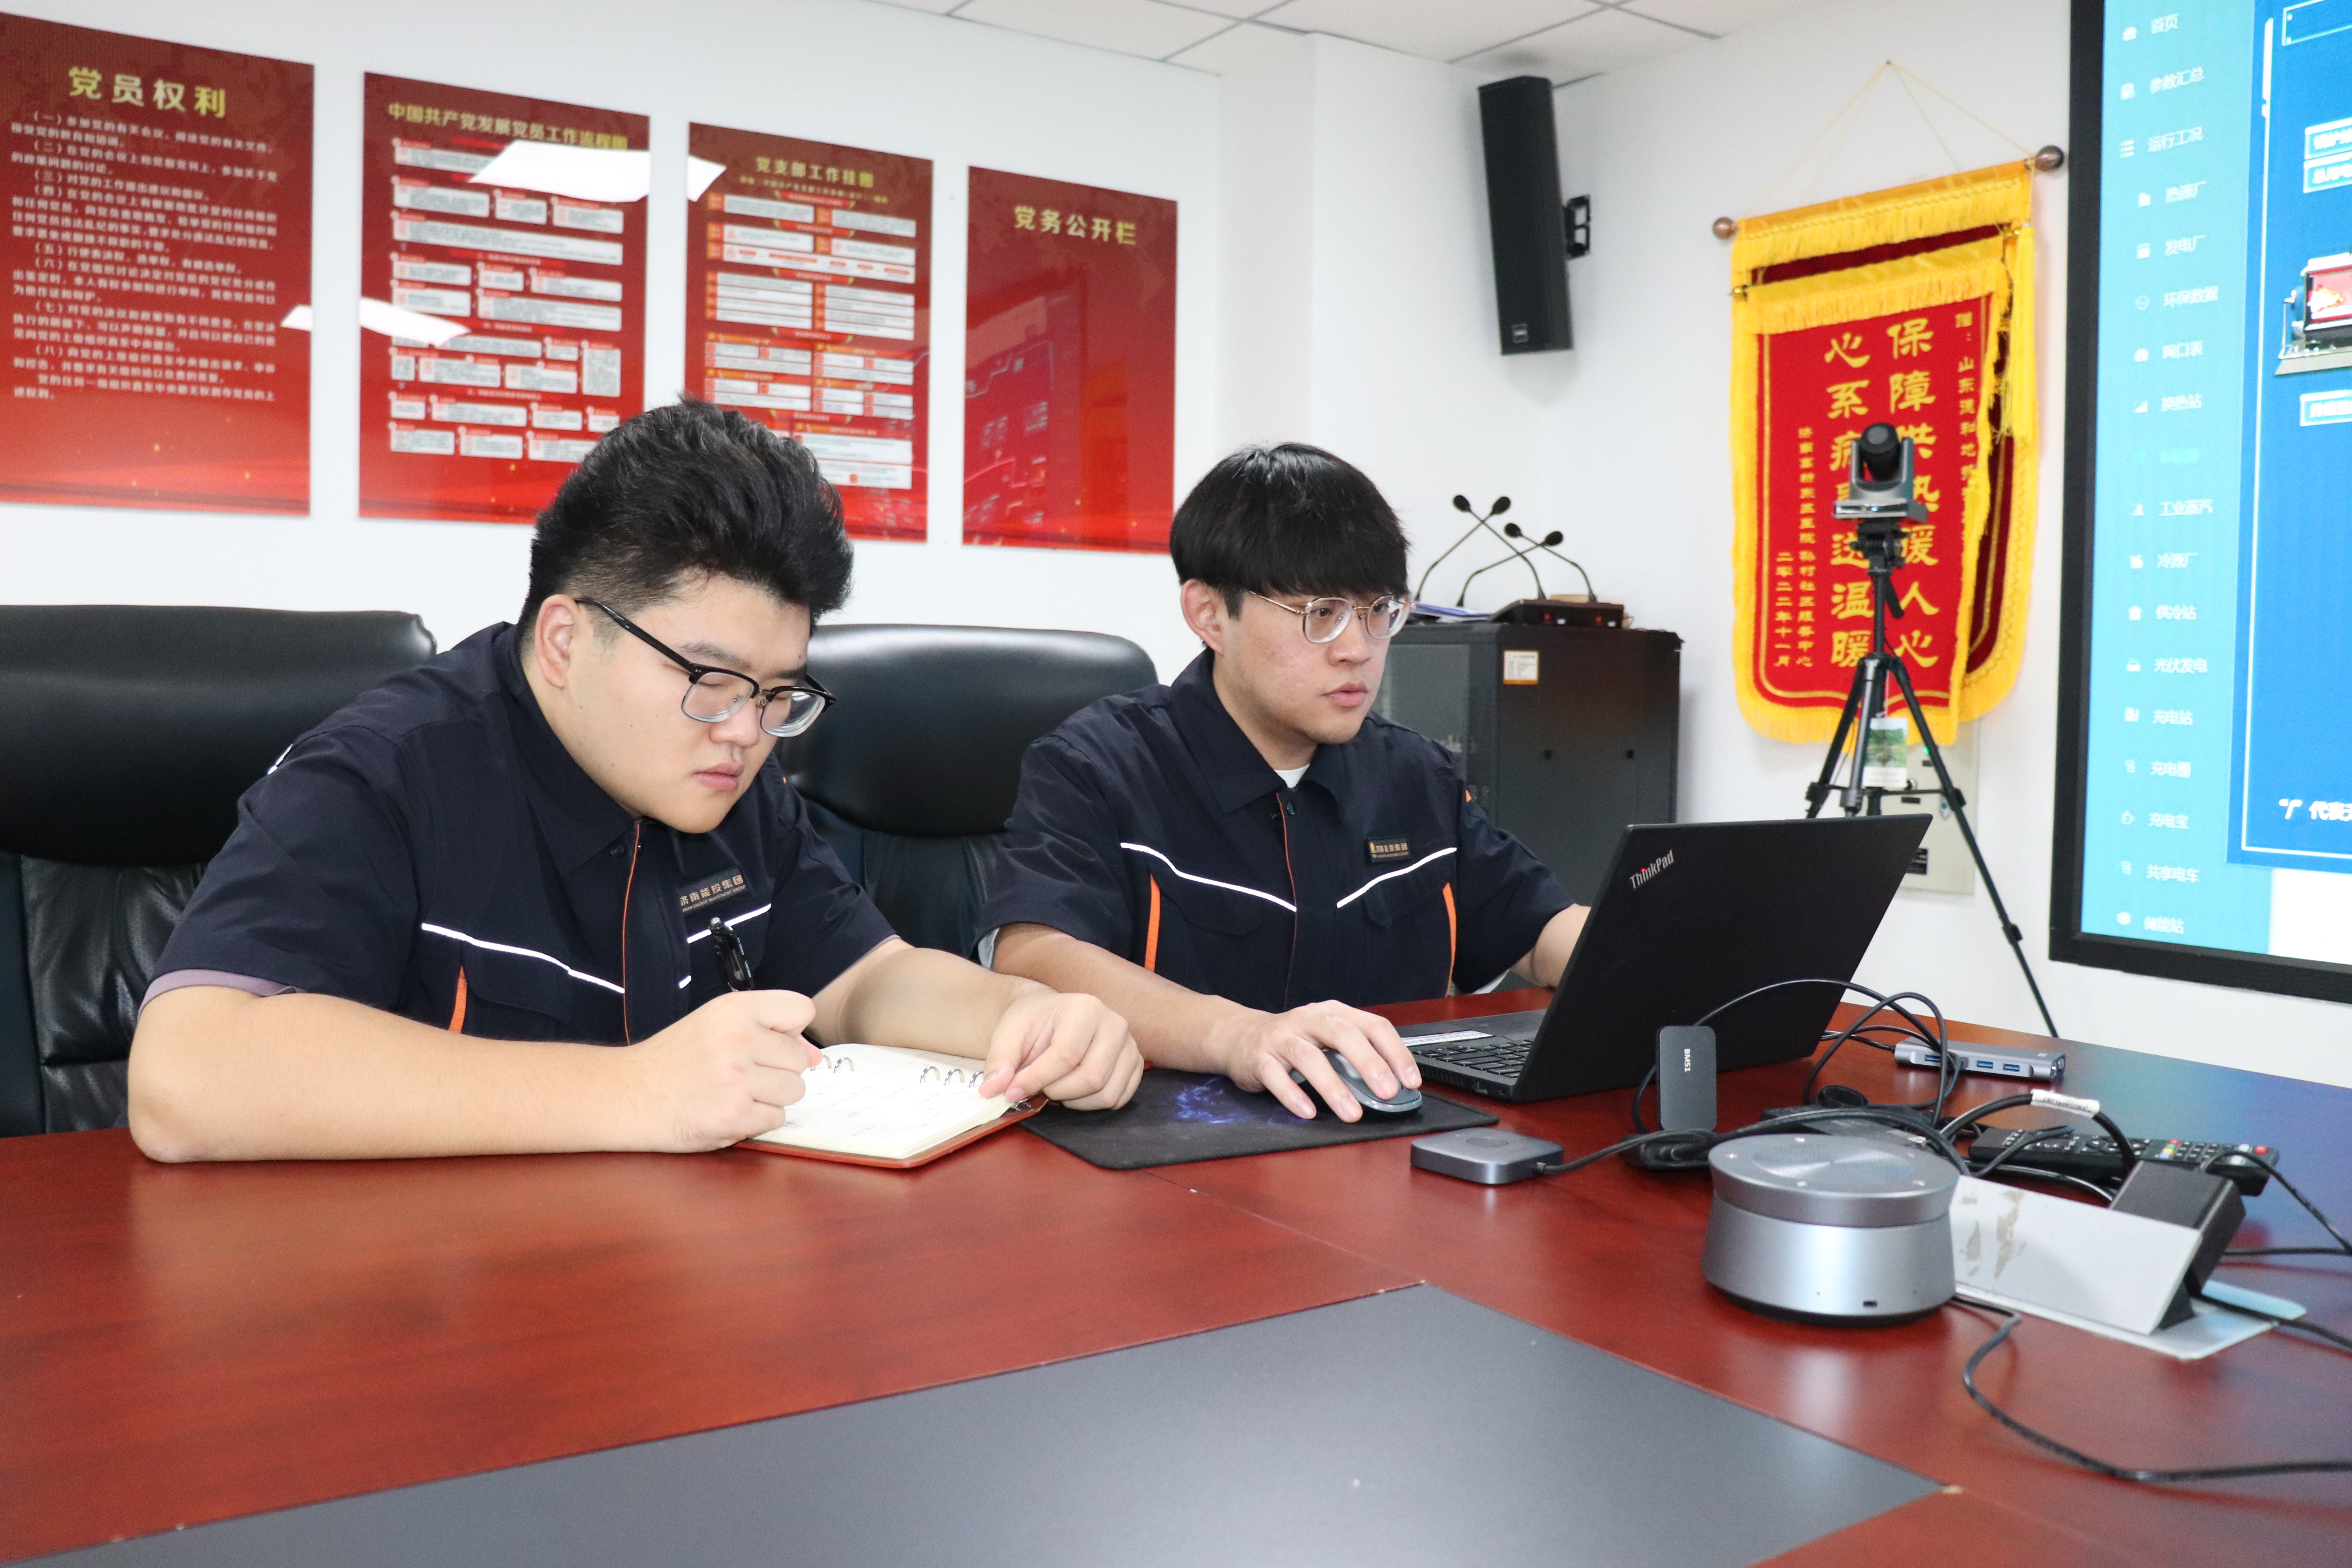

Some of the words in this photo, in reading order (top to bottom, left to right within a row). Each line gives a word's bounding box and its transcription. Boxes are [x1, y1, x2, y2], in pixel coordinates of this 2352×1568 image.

[2151, 14, 2178, 34] 首页
[2150, 67, 2204, 93] 参数汇总
[68, 67, 226, 118] 党员权利
[388, 102, 628, 150] 中国共产党发展党员工作流程图
[2149, 127, 2203, 152] 运行工况
[2166, 181, 2207, 202] 热源厂
[1014, 205, 1136, 246] 党务公开栏
[2165, 236, 2205, 256] 发电厂
[2164, 286, 2218, 307] 环保数据
[2162, 394, 2201, 411] 换热站
[1824, 332, 1875, 667] 心系病送温暖
[2160, 499, 2213, 516] 工业蒸汽
[2158, 553, 2197, 568] 冷源厂
[1774, 552, 1794, 666] 二零二二年十一月
[2156, 605, 2196, 620] 供冷站
[2155, 659, 2207, 673] 光伏发电
[2153, 710, 2193, 725] 充电站
[2151, 762, 2191, 777] 充电棚
[2149, 813, 2188, 829] 充电宝
[1630, 849, 1674, 889] ThinkPad
[2147, 865, 2199, 883] 共享电车
[680, 874, 744, 906] 济南能投集团
[693, 899, 709, 909] ENERGY
[708, 890, 732, 902] INVESTMENT
[2144, 916, 2184, 934] 储能站
